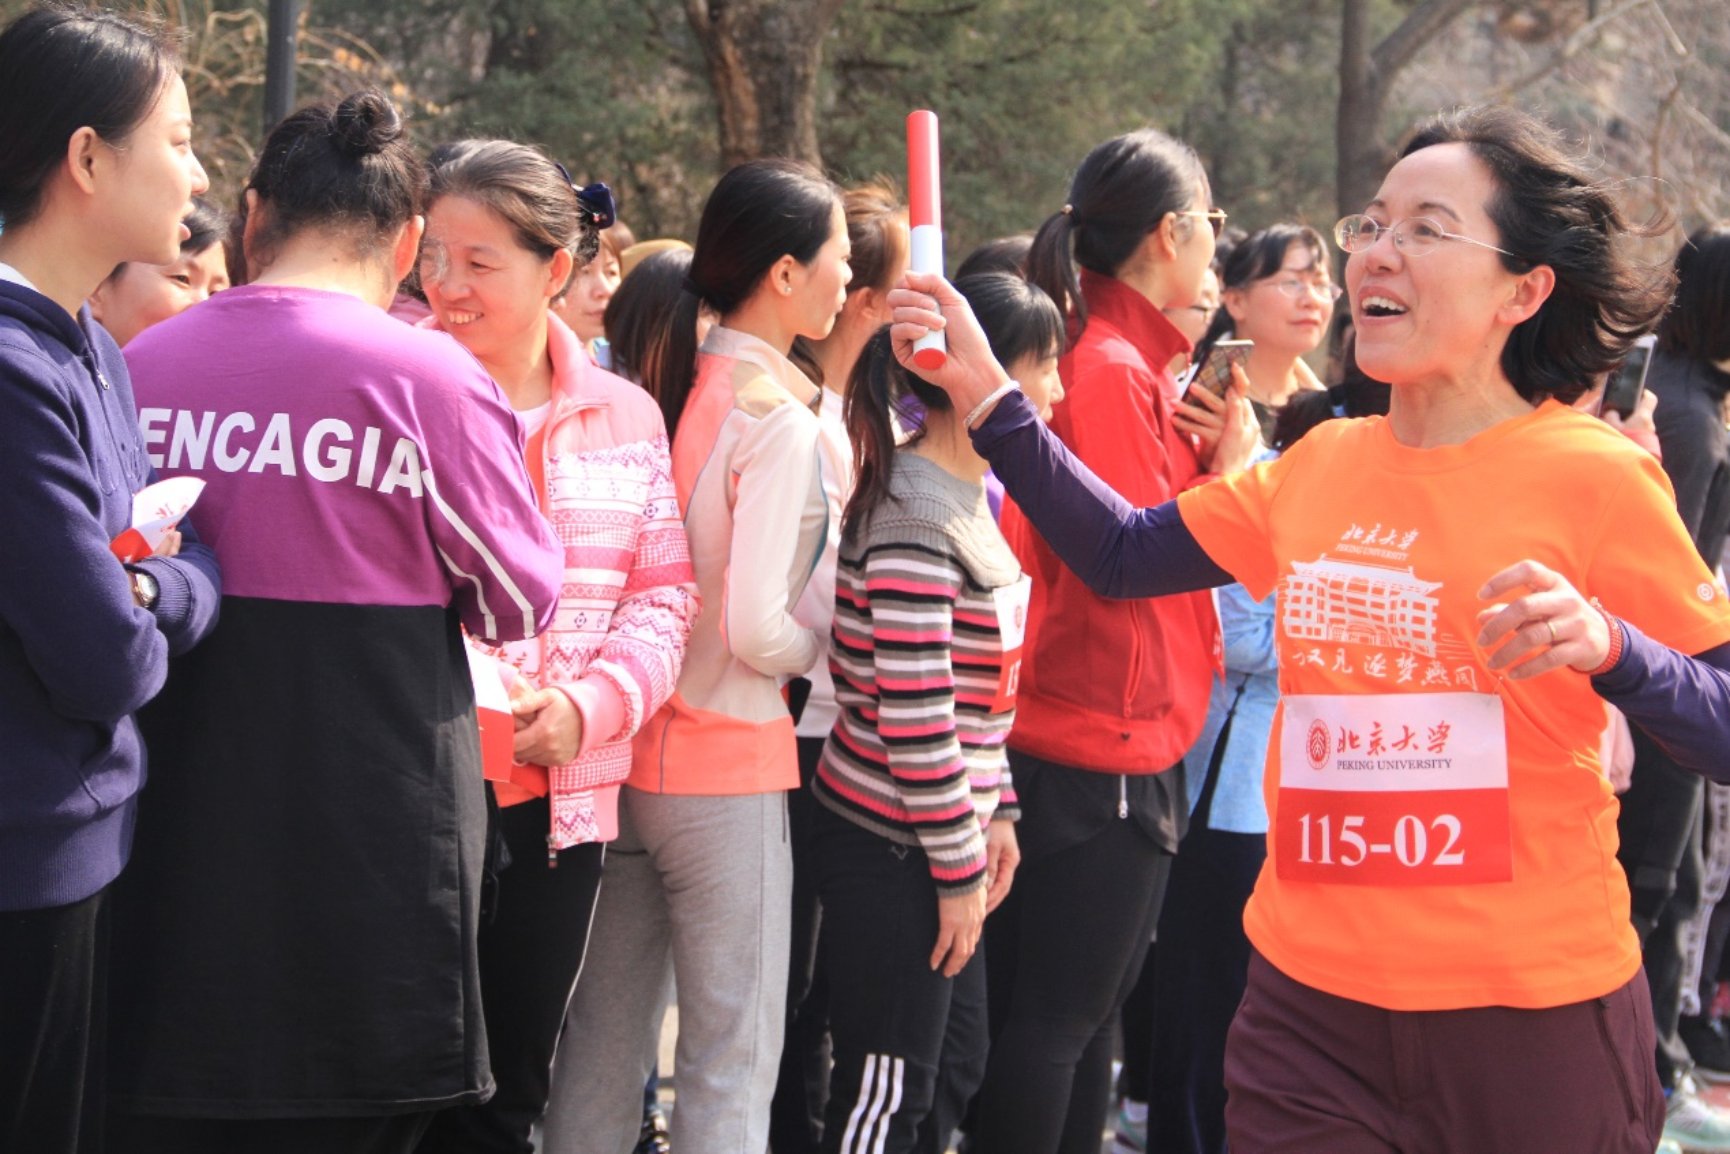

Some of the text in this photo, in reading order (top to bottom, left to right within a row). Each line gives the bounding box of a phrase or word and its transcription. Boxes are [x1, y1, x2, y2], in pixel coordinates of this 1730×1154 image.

[137, 408, 423, 498] ENCAGIA
[1337, 720, 1450, 756] 北京大学
[1337, 758, 1452, 771] PEKING UNIVERSITY
[1297, 813, 1465, 868] 115-02
